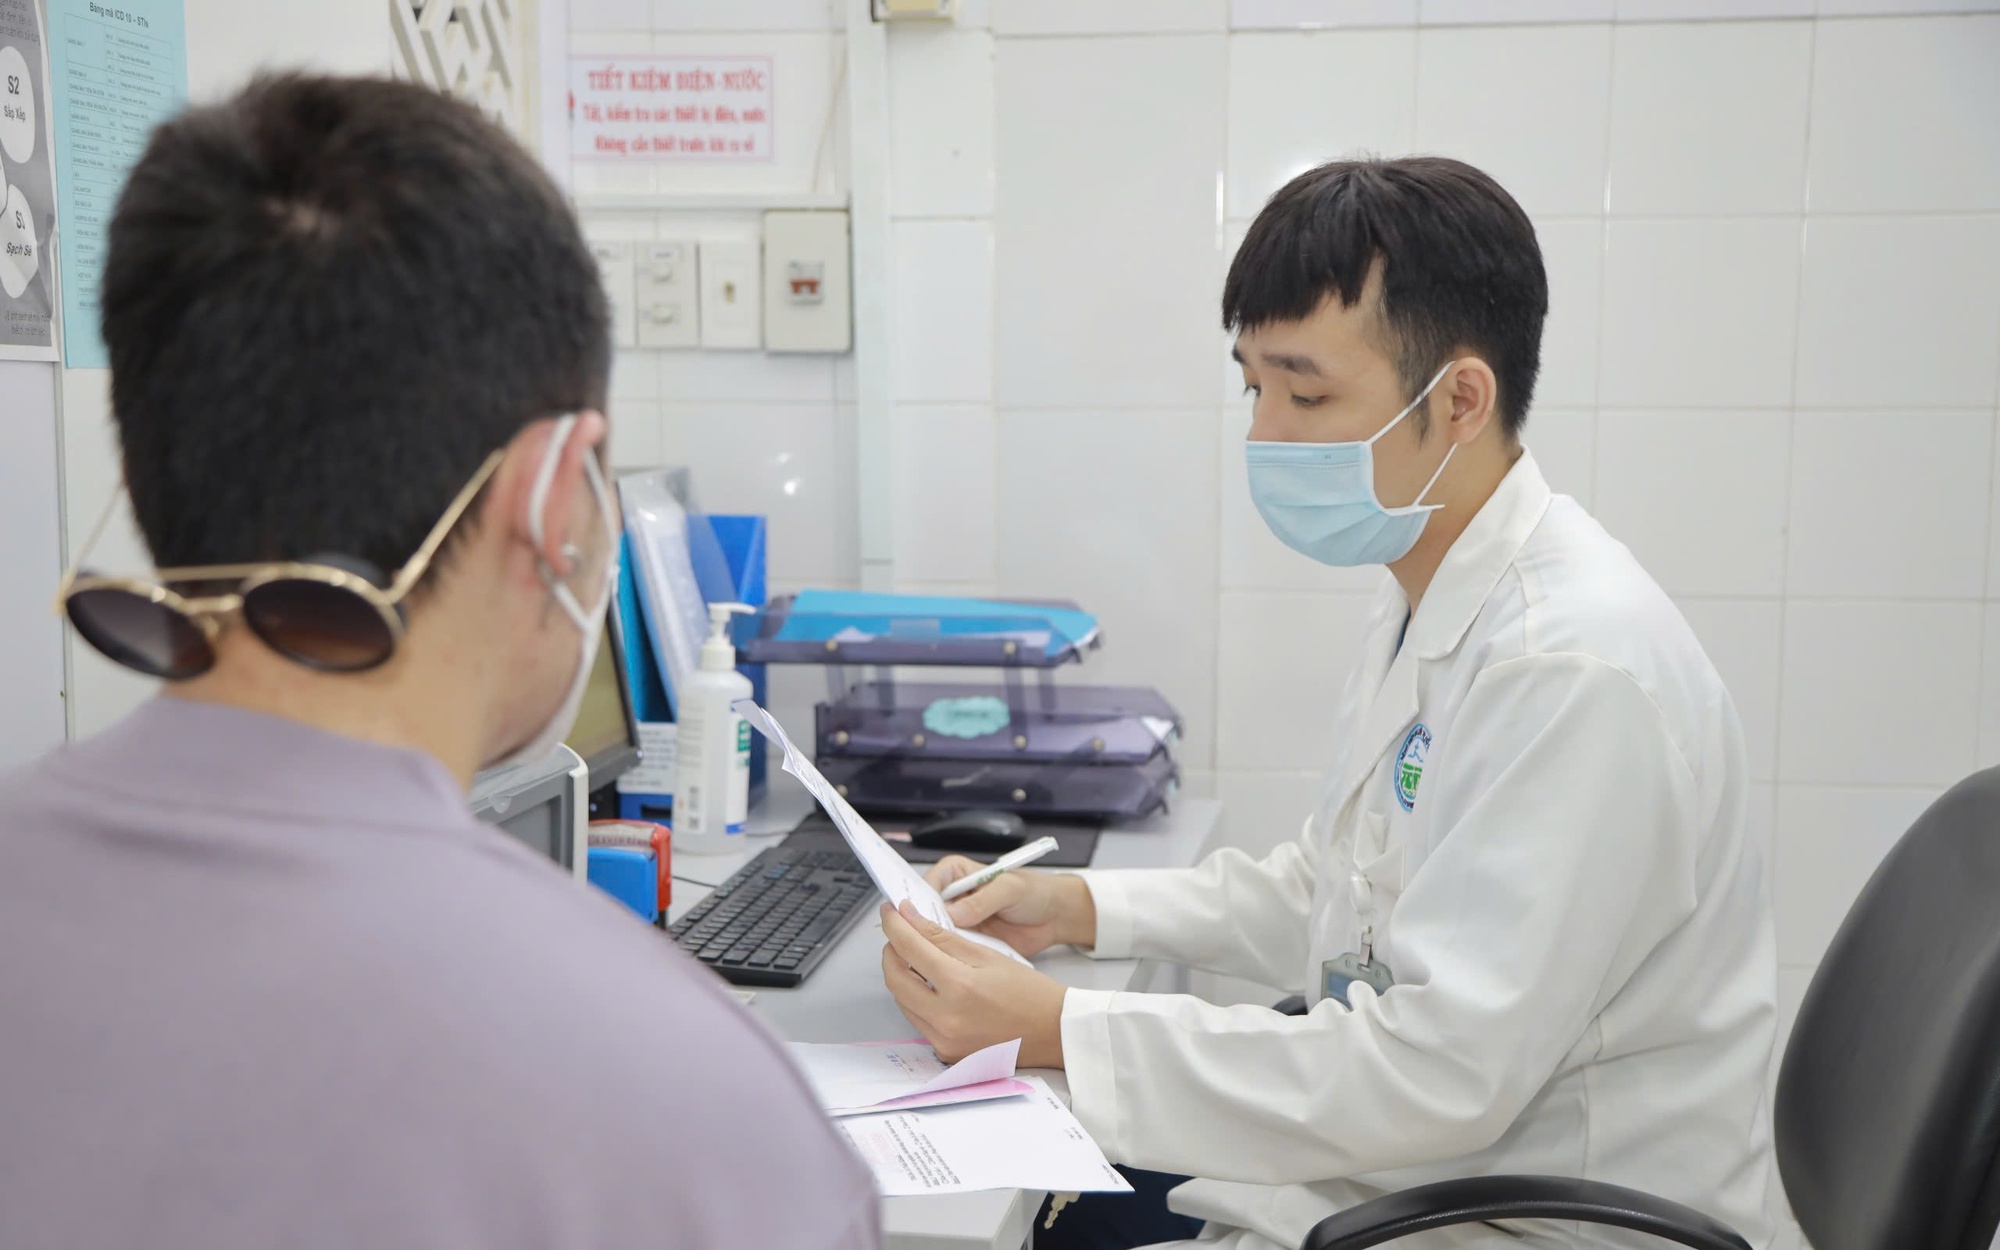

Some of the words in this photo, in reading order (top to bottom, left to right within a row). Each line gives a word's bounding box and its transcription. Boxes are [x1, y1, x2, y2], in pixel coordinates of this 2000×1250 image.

[8, 75, 19, 95] S2
[588, 64, 624, 91] TIẾT
[630, 66, 671, 93] KIỆM
